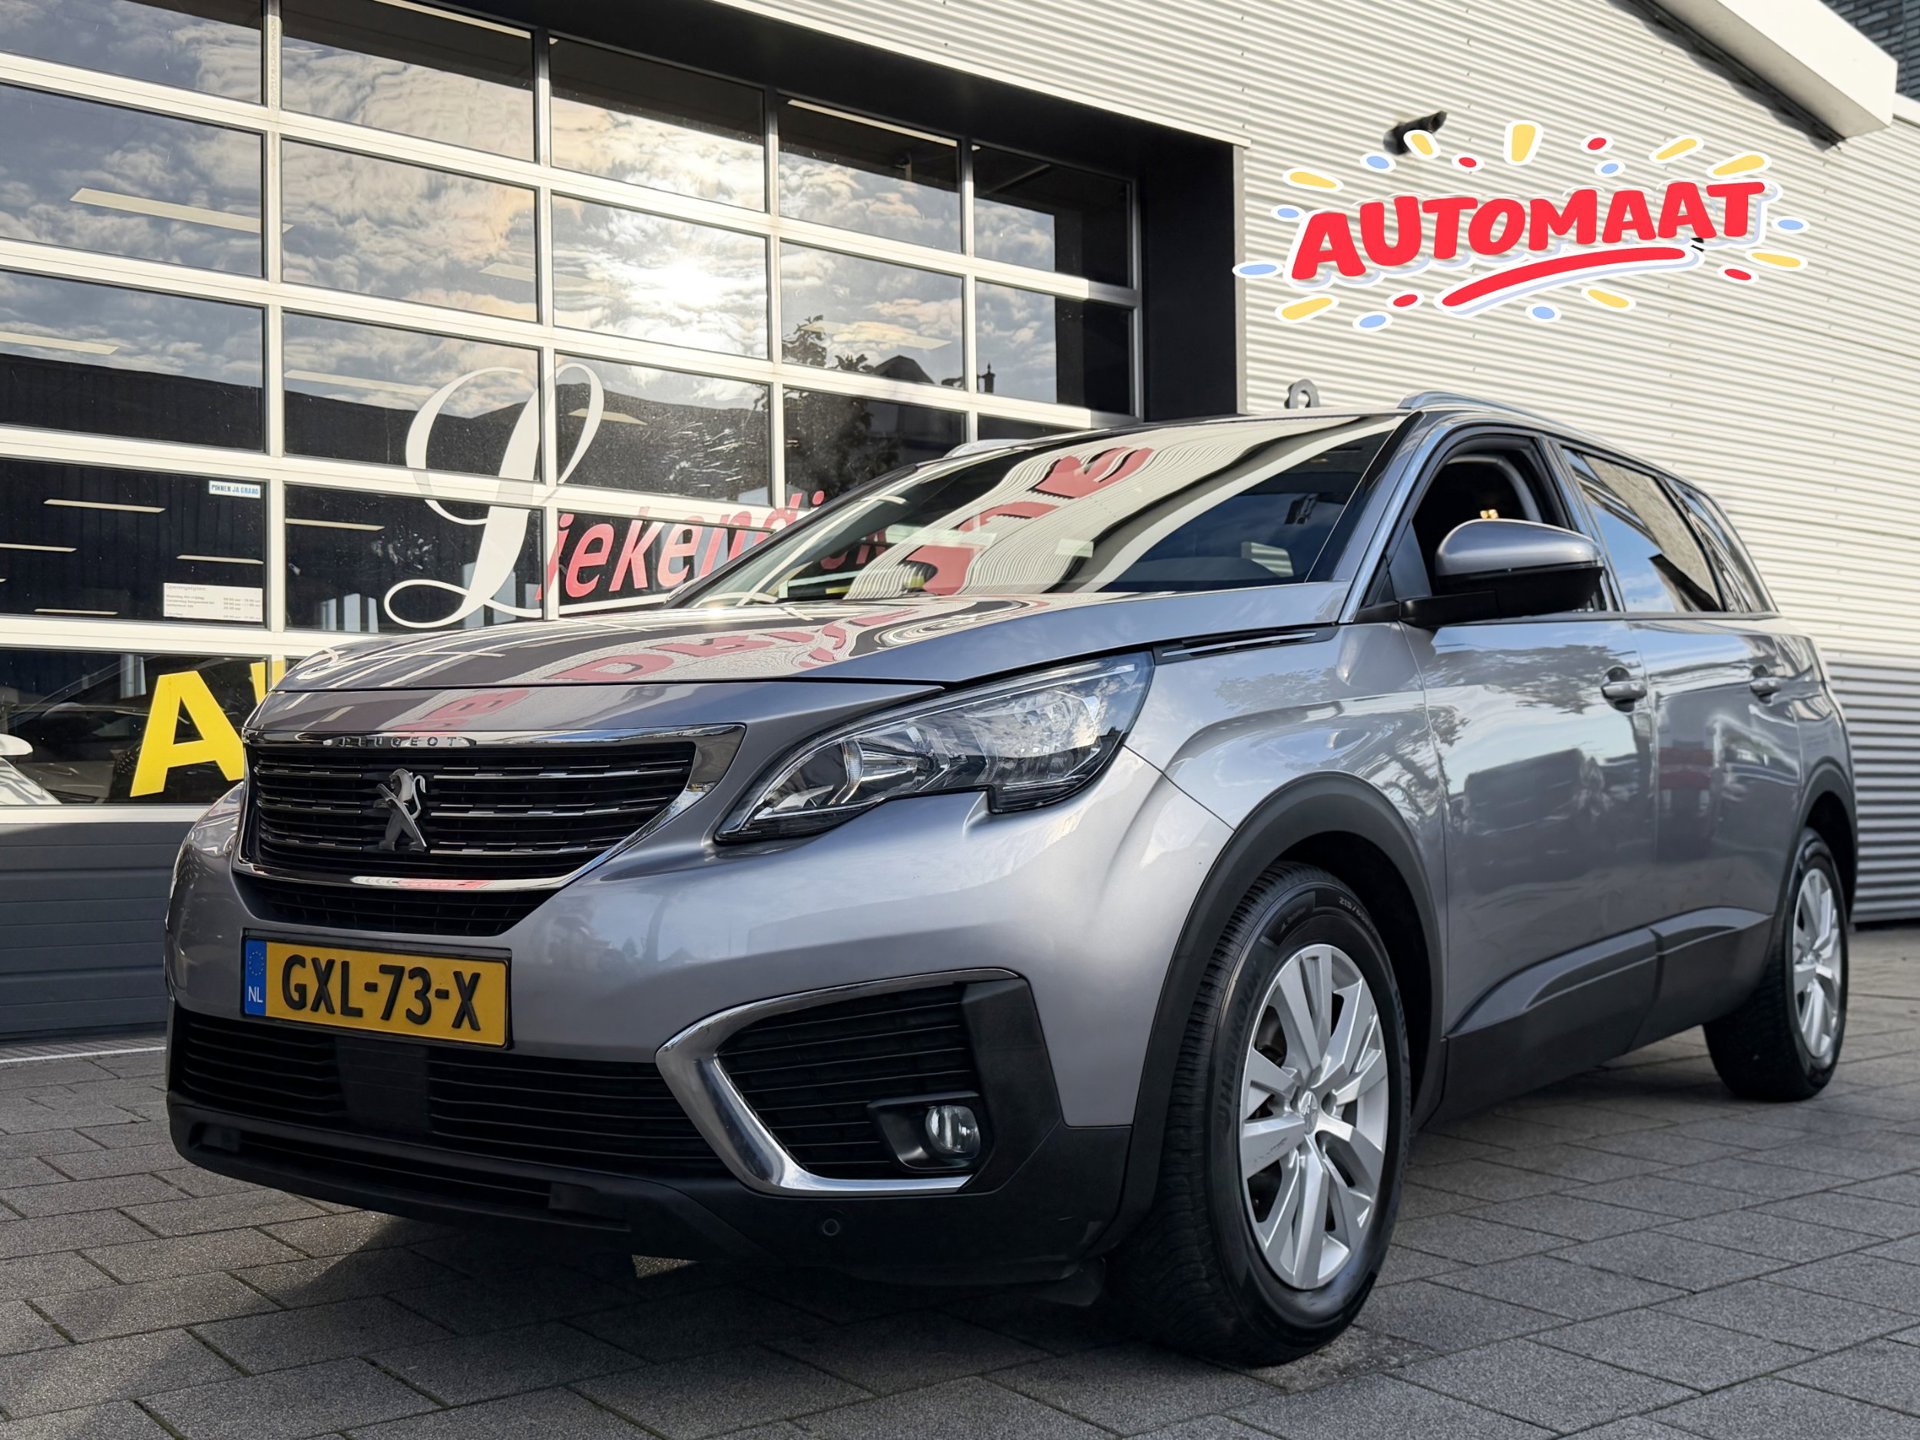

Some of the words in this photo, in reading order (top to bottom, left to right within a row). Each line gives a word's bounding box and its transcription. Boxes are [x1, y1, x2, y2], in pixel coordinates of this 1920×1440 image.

[338, 735, 458, 748] PEUGEOT
[248, 985, 264, 1004] NL
[281, 953, 482, 1032] GXL-73-X
